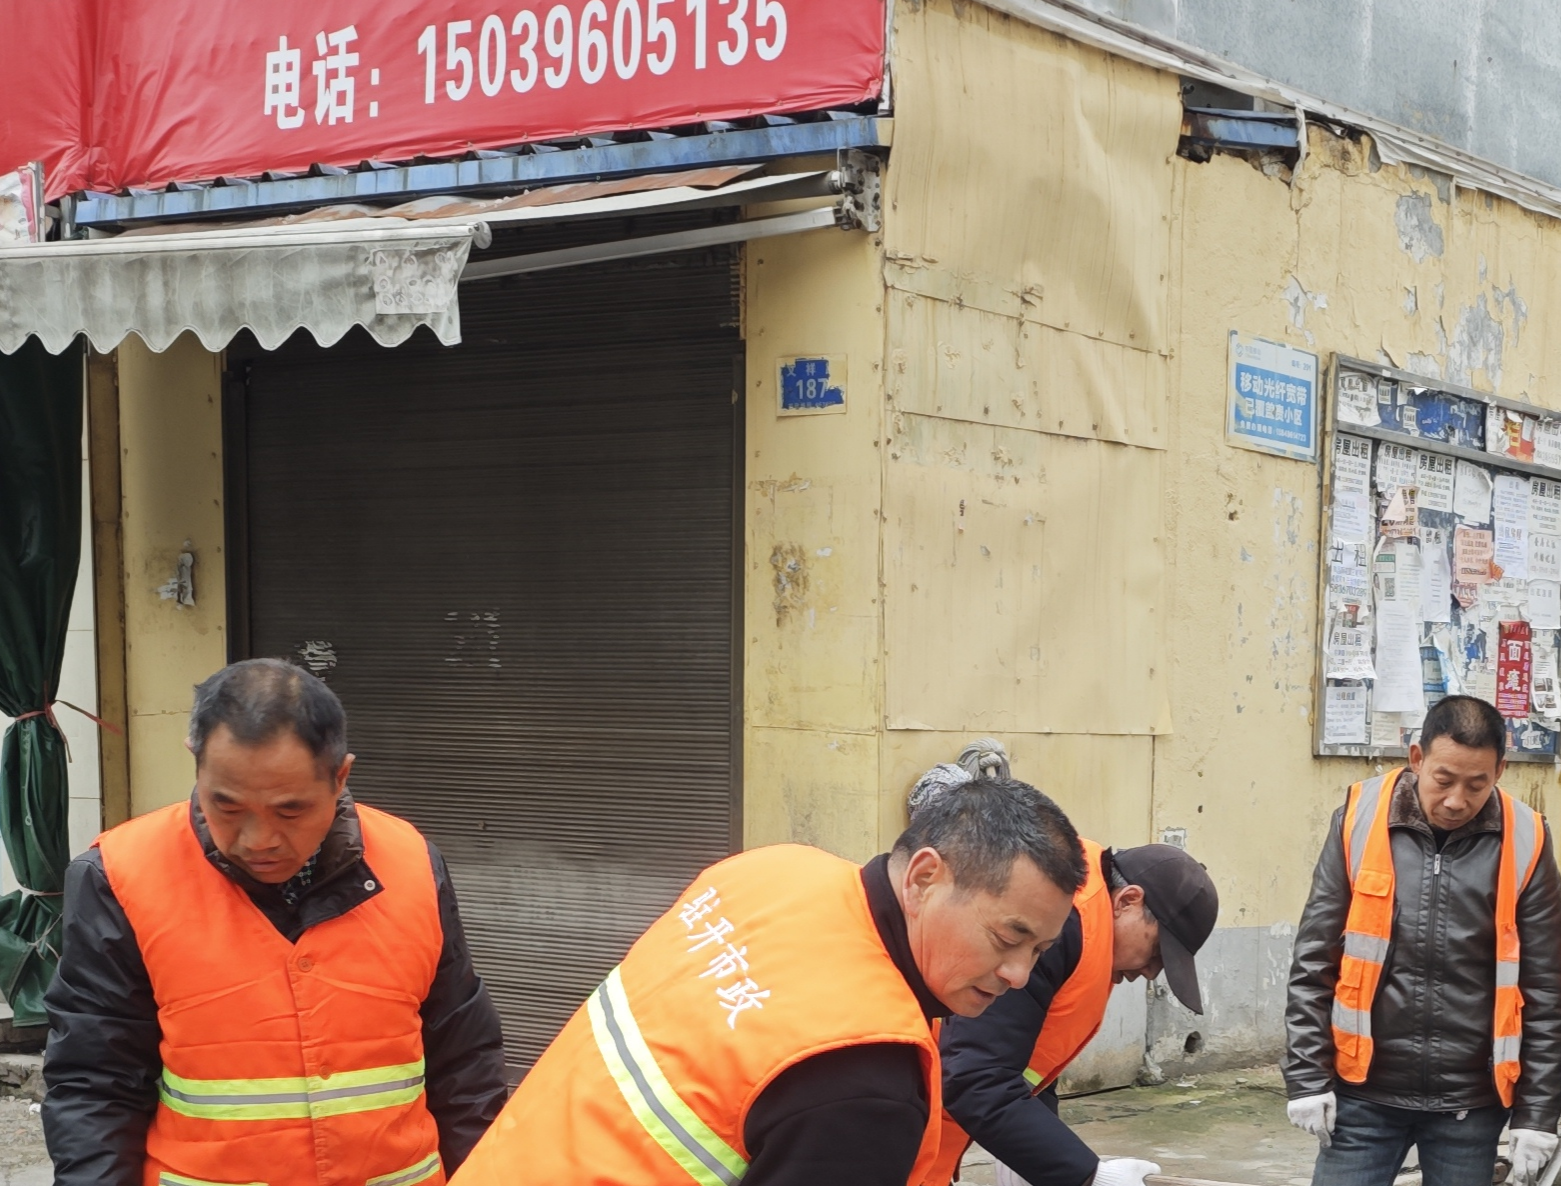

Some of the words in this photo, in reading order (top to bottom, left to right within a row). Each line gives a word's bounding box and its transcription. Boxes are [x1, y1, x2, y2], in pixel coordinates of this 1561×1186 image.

[417, 0, 789, 104] 15039605135
[786, 361, 829, 377] 文祥
[796, 378, 829, 400] 187
[1240, 371, 1307, 406] 移动光纤宽带
[1419, 454, 1452, 475] 房屋出租
[1531, 481, 1561, 500] 房屋出租
[1332, 540, 1366, 567] 出租
[1333, 631, 1361, 646] 房屋出租
[678, 886, 771, 1030] 驻开市政
